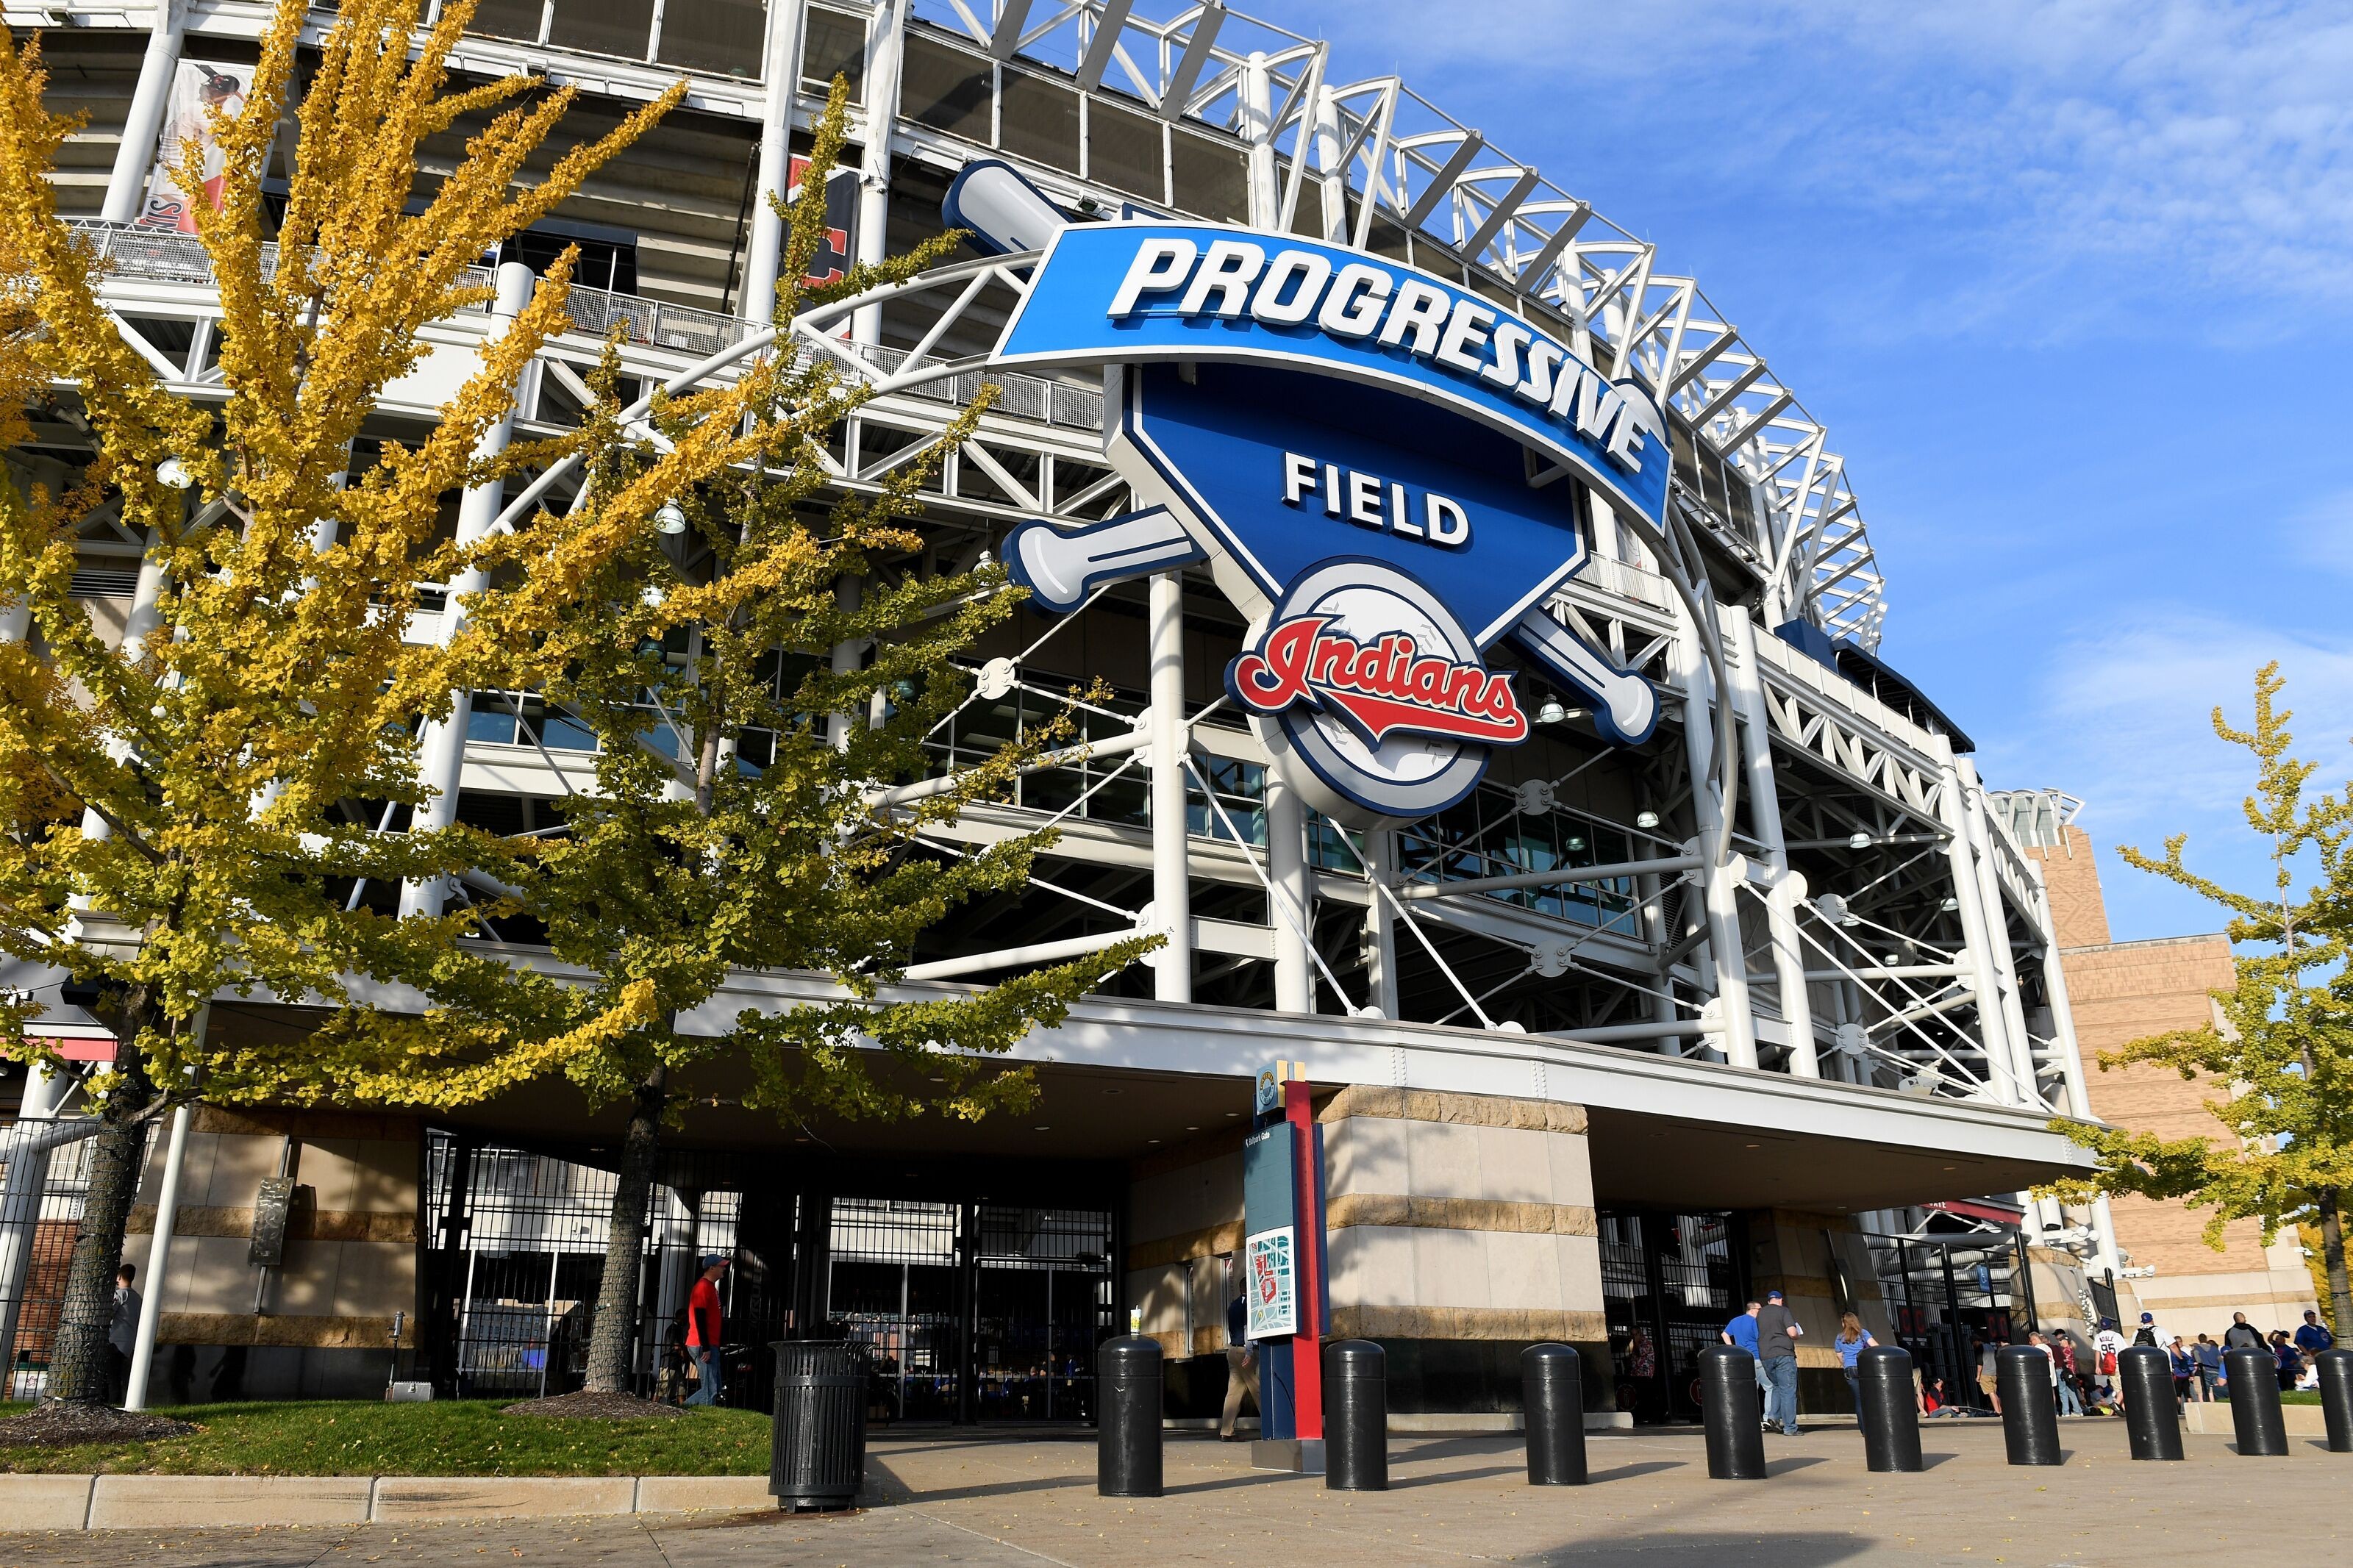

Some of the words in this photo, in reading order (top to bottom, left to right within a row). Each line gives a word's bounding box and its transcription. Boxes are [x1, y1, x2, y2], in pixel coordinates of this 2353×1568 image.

[1106, 237, 1654, 473] PROGRESSIVE
[1282, 451, 1470, 545] FIELD
[1234, 616, 1529, 742] Indians
[1261, 1131, 1270, 1140] Gate
[2101, 1343, 2116, 1356] 95
